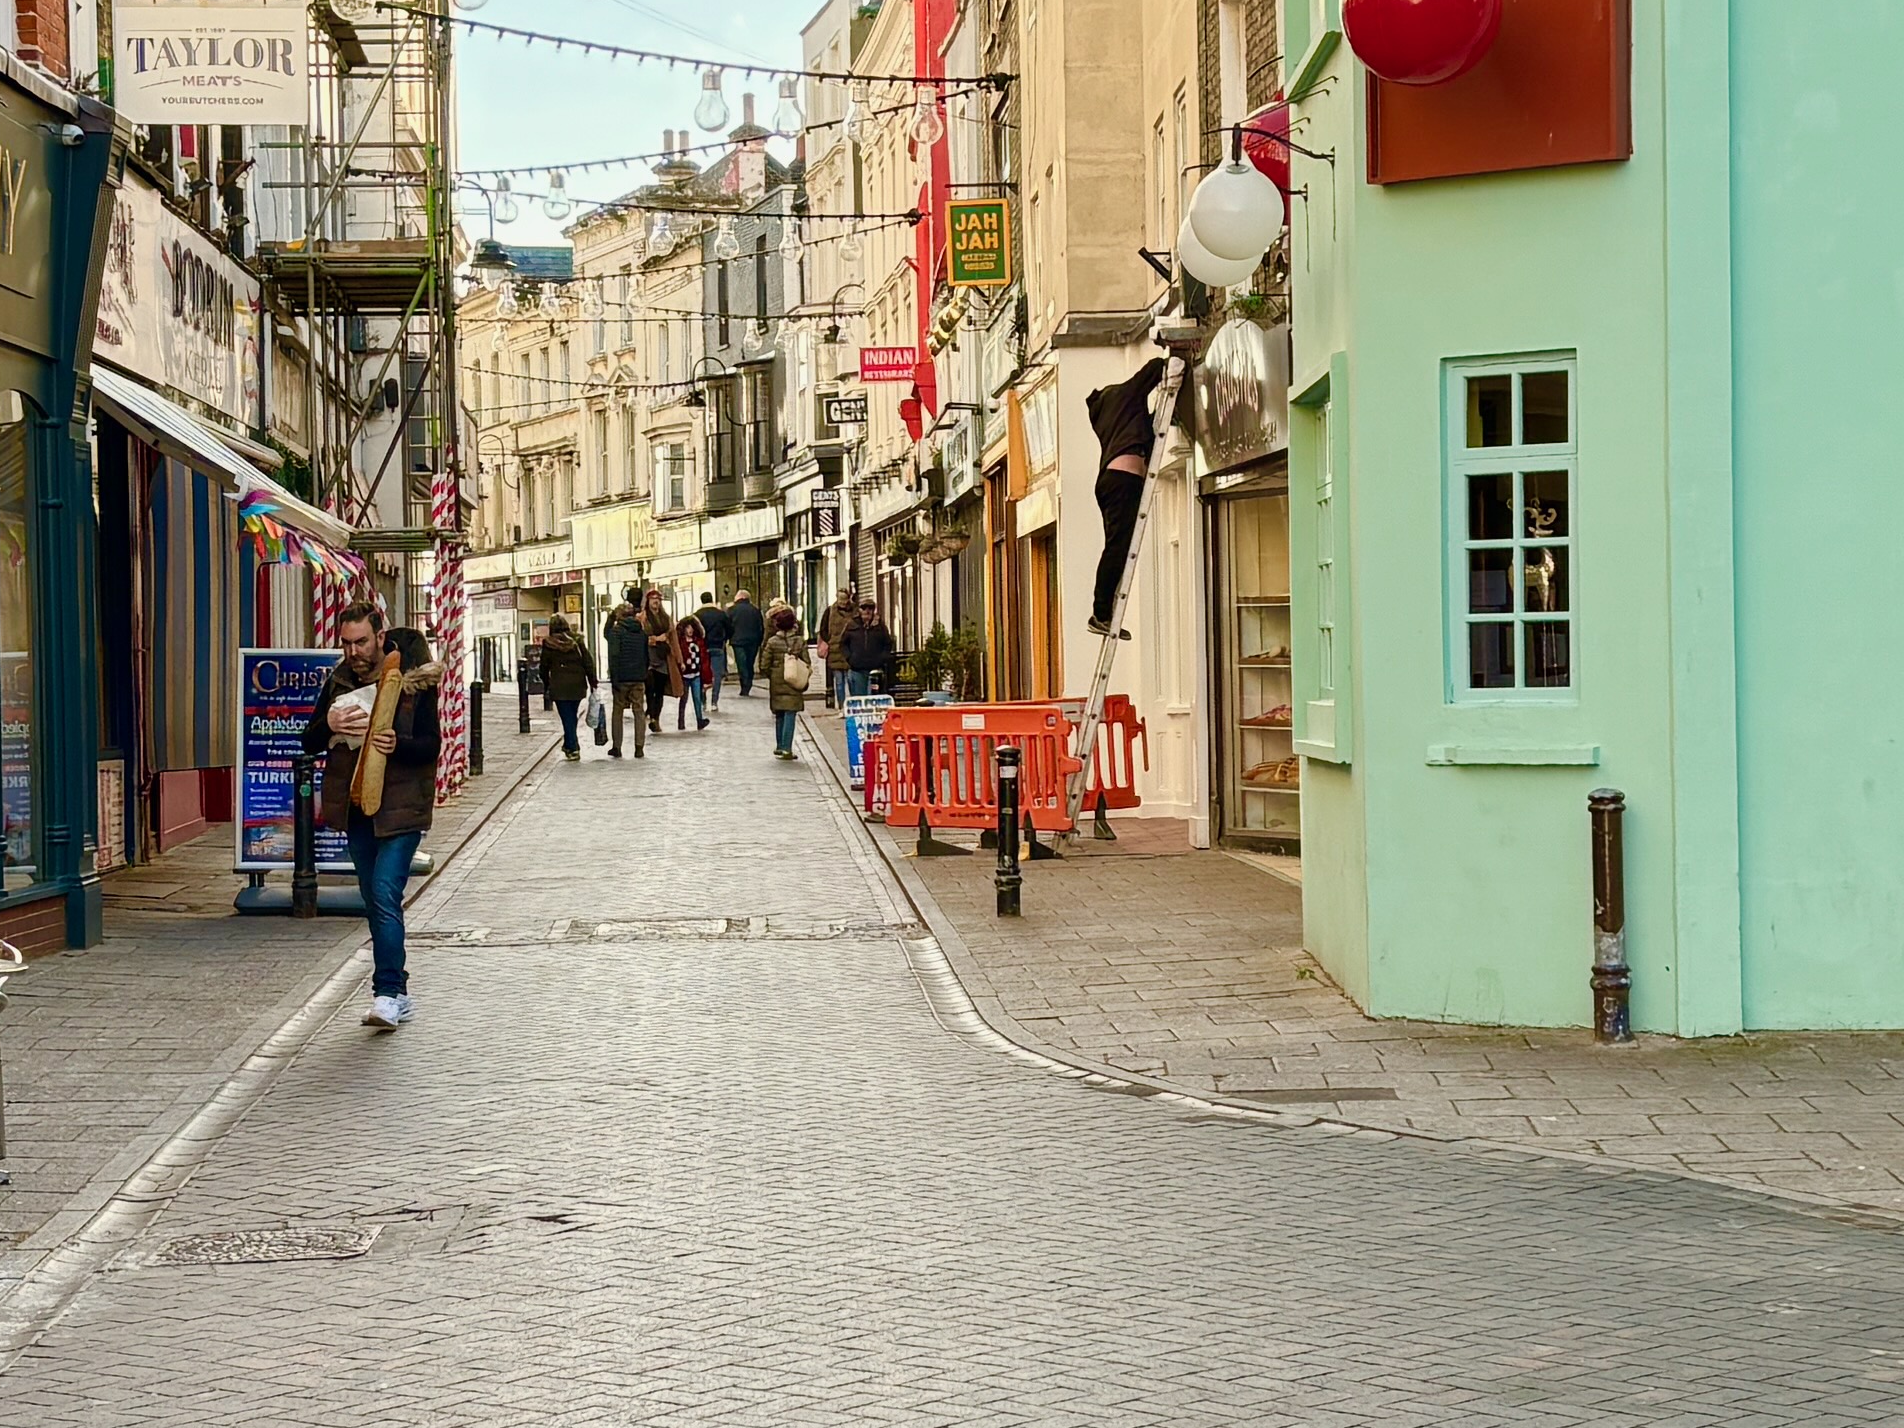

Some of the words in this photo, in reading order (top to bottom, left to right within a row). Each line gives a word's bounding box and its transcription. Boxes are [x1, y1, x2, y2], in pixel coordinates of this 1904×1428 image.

[127, 36, 296, 77] TAYLOR
[183, 75, 243, 88] MEATS
[955, 212, 998, 231] JAH
[955, 231, 999, 250] JAH
[864, 350, 913, 365] INDIAN
